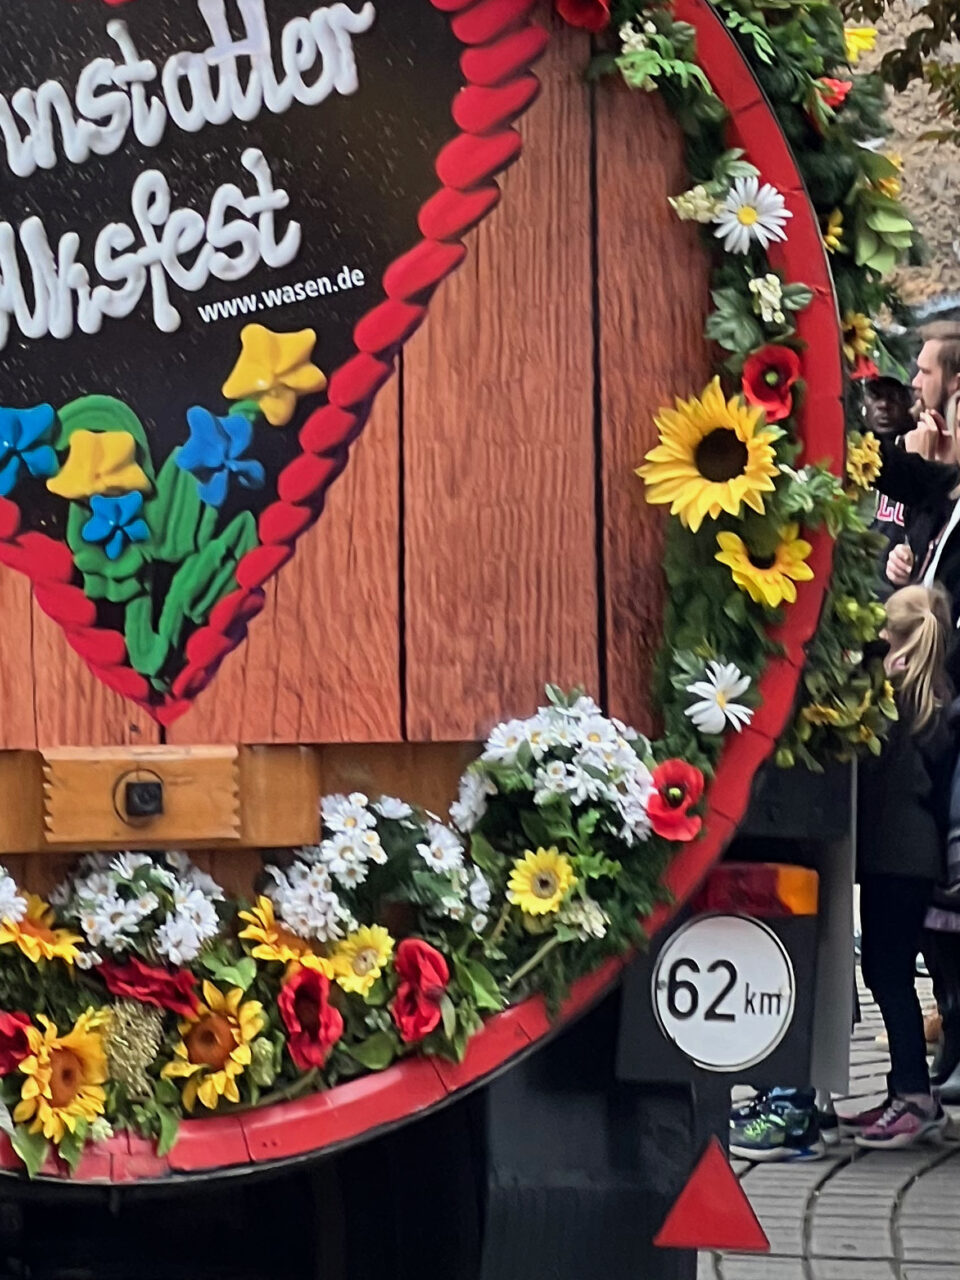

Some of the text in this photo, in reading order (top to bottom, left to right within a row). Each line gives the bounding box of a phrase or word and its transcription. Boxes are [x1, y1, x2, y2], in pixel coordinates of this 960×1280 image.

[197, 265, 366, 323] www.wasen.de
[667, 957, 782, 1022] 62 km
